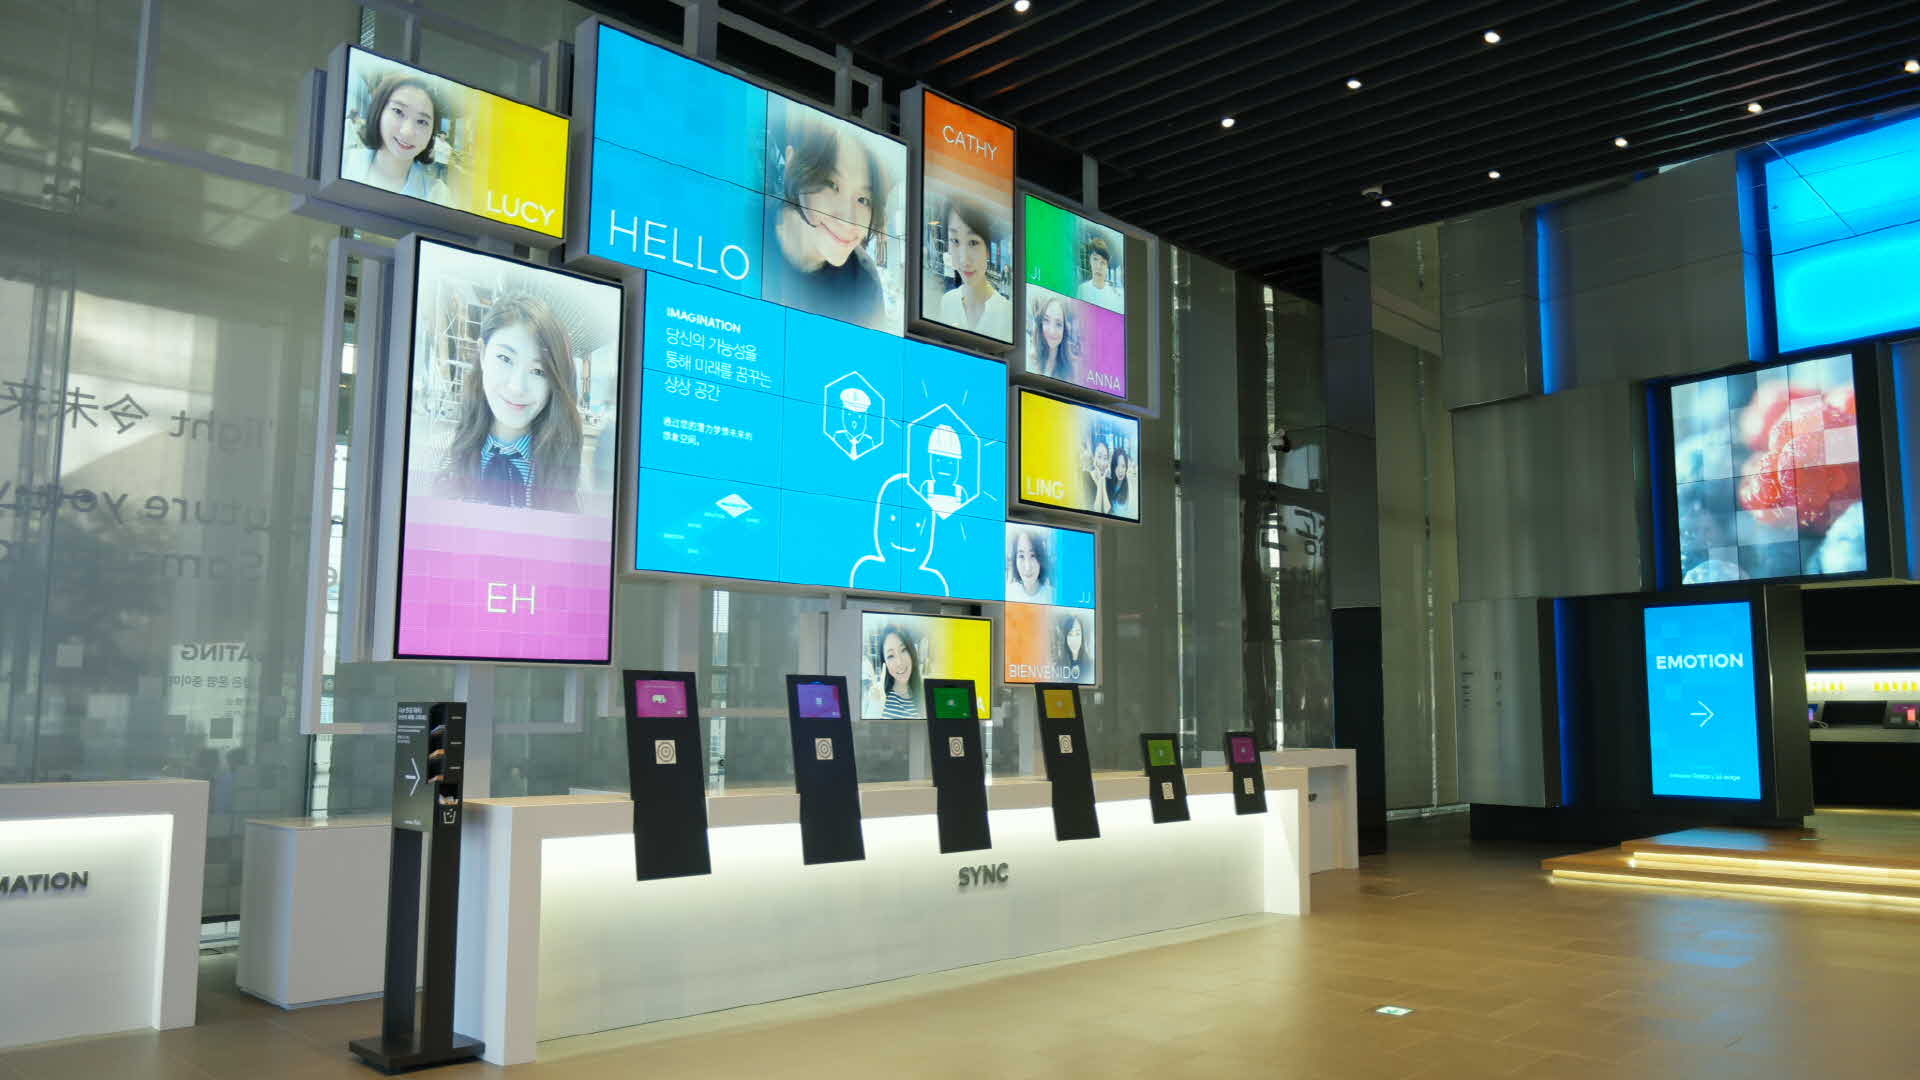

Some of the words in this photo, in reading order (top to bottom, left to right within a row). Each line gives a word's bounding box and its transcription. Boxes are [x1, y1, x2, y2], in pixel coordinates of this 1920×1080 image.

[942, 125, 998, 161] CATHY
[487, 191, 555, 227] LUCY
[609, 209, 749, 280] HELLO
[666, 307, 741, 334] IMAGINATION
[666, 327, 705, 350] 당신의
[708, 337, 758, 362] 가능성을
[666, 350, 691, 372] 통해
[695, 358, 732, 380] 미래를
[736, 366, 772, 389] 꿈꾸는
[1087, 369, 1121, 391] ANNA
[664, 376, 691, 396] 상상
[695, 381, 720, 402] 공간
[1026, 475, 1065, 500] LING
[487, 583, 535, 616] EH
[1008, 664, 1081, 680] BIENVENIDO
[1656, 653, 1744, 670] EMOTION
[958, 862, 1009, 887] SYNC
